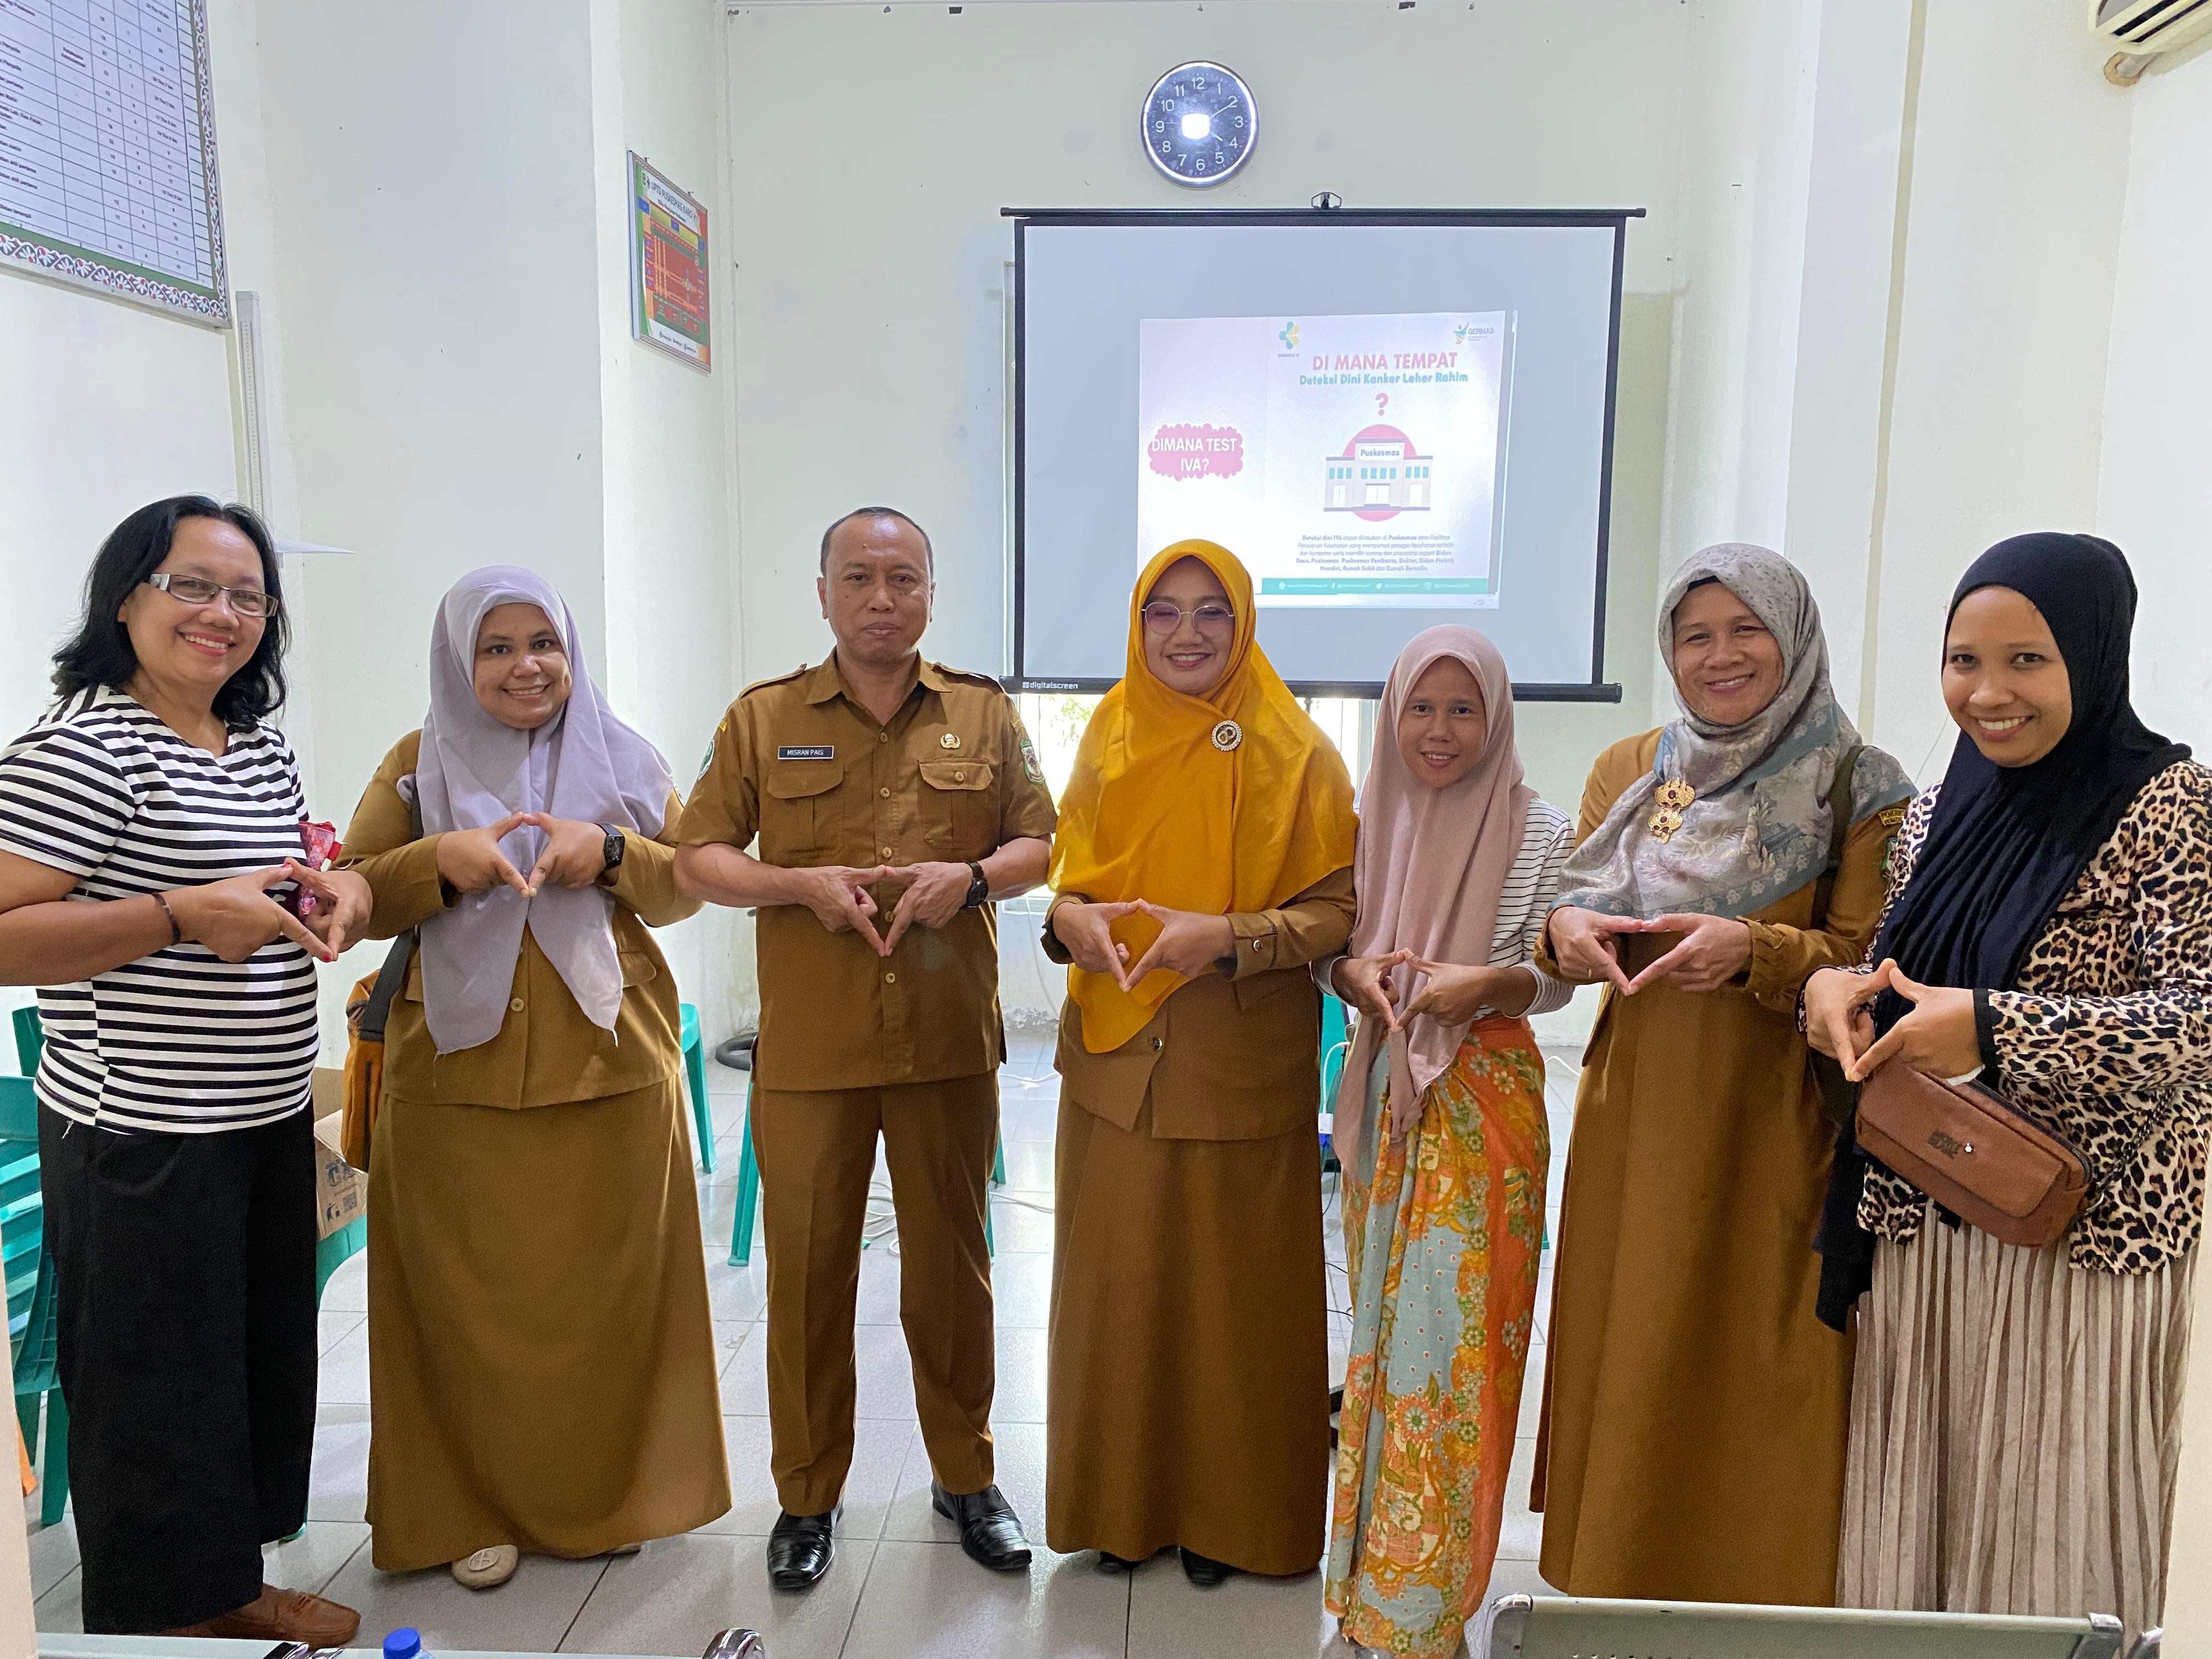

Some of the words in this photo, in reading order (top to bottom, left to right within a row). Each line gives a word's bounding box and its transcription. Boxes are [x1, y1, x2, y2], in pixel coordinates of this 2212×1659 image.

[1192, 77, 1205, 89] 12
[1217, 82, 1221, 94] 1
[1175, 84, 1184, 97] 11
[1161, 99, 1174, 112] 10
[1228, 95, 1238, 108] 2
[1156, 121, 1164, 132] 9
[1234, 116, 1243, 128] 3
[1163, 141, 1171, 153] 8
[1229, 137, 1238, 148] 4
[1178, 154, 1187, 166] 7
[1215, 152, 1224, 164] 5
[1196, 159, 1205, 171] 6
[1312, 356, 1328, 370] DI
[1335, 354, 1388, 370] MANA
[1393, 352, 1458, 369] TEMPAT
[1300, 374, 1337, 385] Deteksi
[1341, 374, 1361, 384] Dini
[1364, 373, 1400, 383] Kanker
[1403, 372, 1433, 383] Leher
[1436, 371, 1468, 382] Rahim
[1375, 392, 1389, 416] ?
[1152, 438, 1204, 452] DIMANA
[1206, 438, 1237, 452] TEST
[1181, 458, 1209, 471] IVA?
